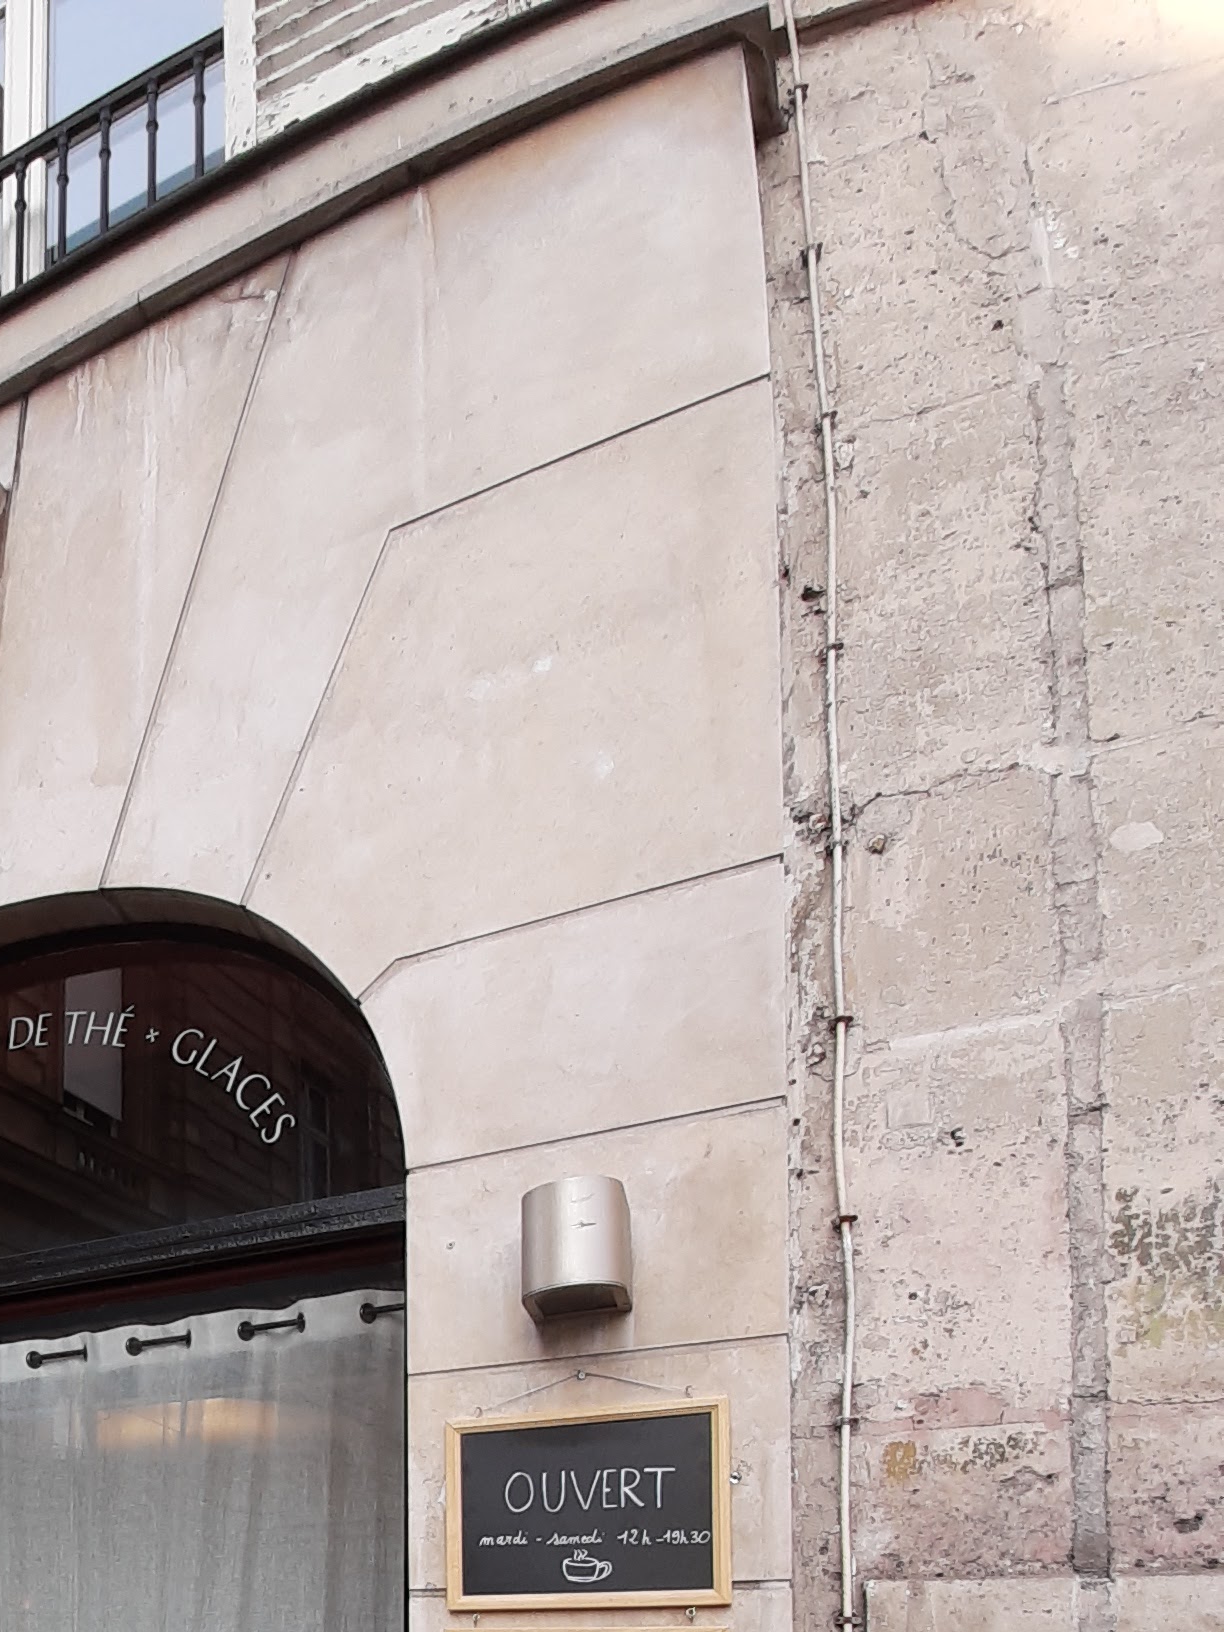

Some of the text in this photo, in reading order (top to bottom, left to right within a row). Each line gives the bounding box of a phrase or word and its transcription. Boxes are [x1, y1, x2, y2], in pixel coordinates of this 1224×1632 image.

[8, 1012, 53, 1051] DE
[63, 1004, 137, 1049] THÉ
[171, 1026, 299, 1146] GLACES
[504, 1466, 676, 1513] OUVERT
[479, 1530, 529, 1547] mardi
[546, 1528, 606, 1547] samedi
